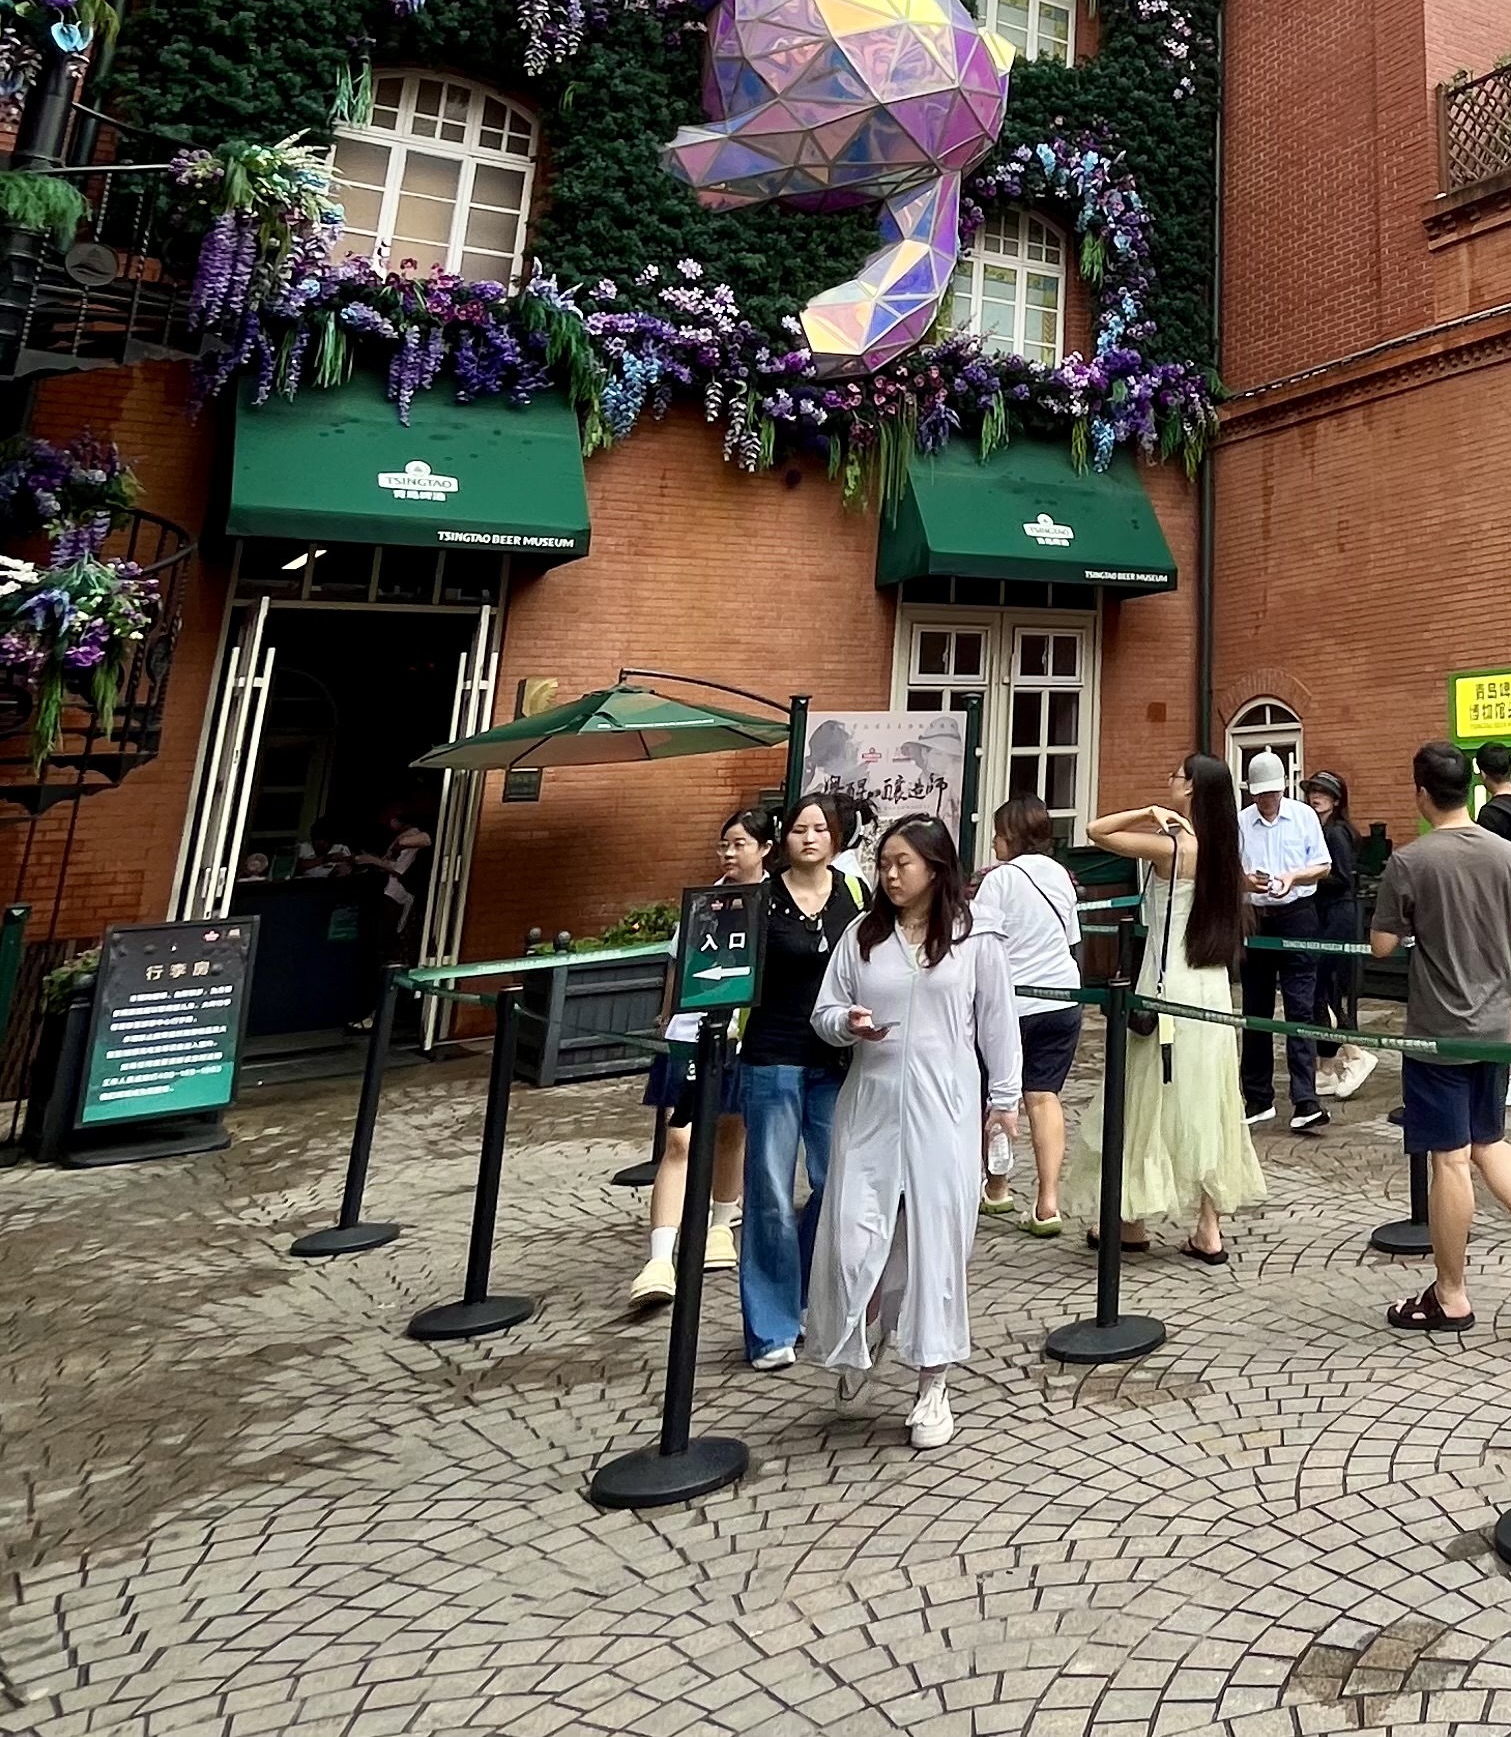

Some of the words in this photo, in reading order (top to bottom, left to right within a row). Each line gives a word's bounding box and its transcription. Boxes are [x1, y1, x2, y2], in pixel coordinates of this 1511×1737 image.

[385, 475, 452, 489] TSINGTAO
[437, 530, 491, 544] TSINGTAO
[491, 534, 521, 546] BEER
[522, 536, 575, 548] MUSEUM
[1084, 570, 1117, 581] TSINGTAO
[1117, 572, 1136, 581] BEER
[1136, 574, 1168, 583] MUSEUM
[700, 931, 747, 951] 入口
